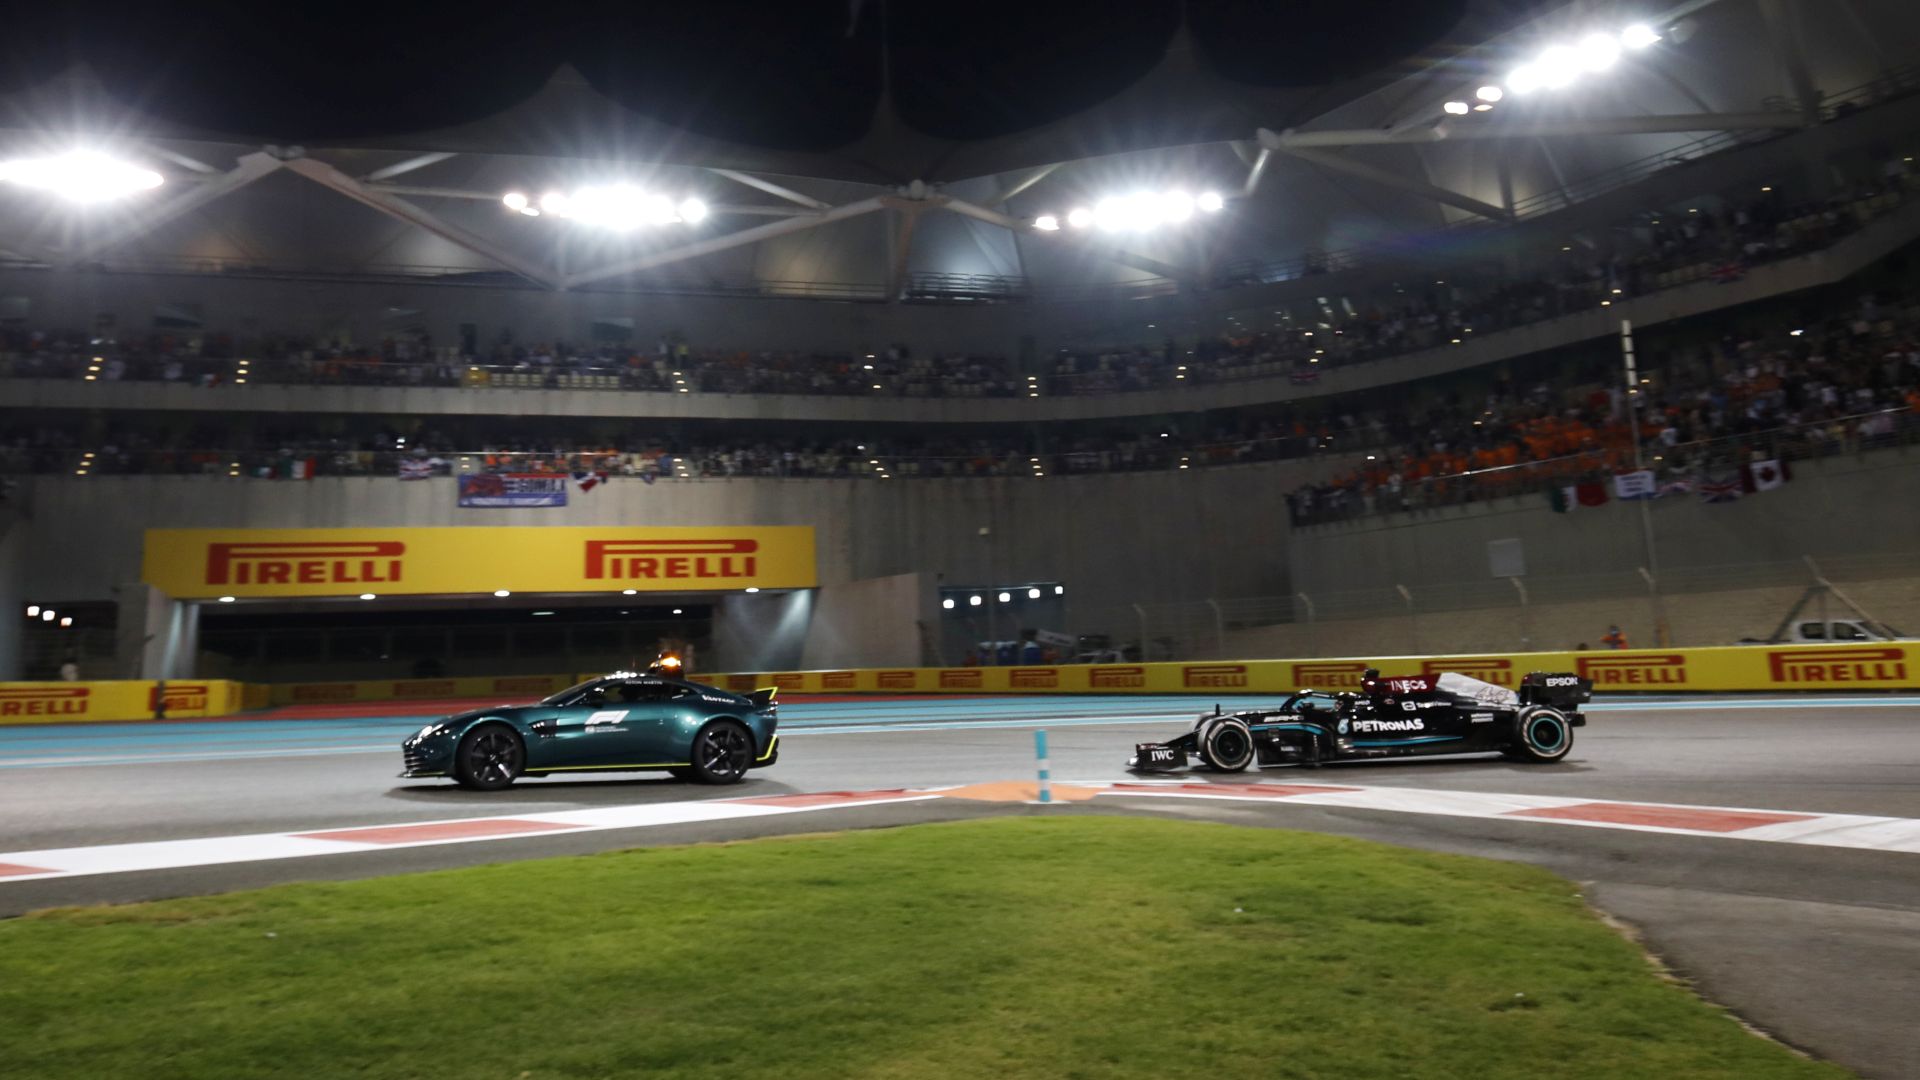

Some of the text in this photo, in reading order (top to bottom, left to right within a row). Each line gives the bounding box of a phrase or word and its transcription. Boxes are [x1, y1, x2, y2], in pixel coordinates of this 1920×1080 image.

[206, 541, 405, 585] PIRELLI
[584, 539, 757, 579] PIRELLI
[1576, 655, 1685, 684] PIRELLI
[1769, 648, 1907, 682] PIRELLI
[1390, 680, 1428, 691] INEOS
[1546, 677, 1579, 687] EPSON
[1352, 718, 1425, 733] PETRONAS
[1151, 750, 1175, 762] IWC
